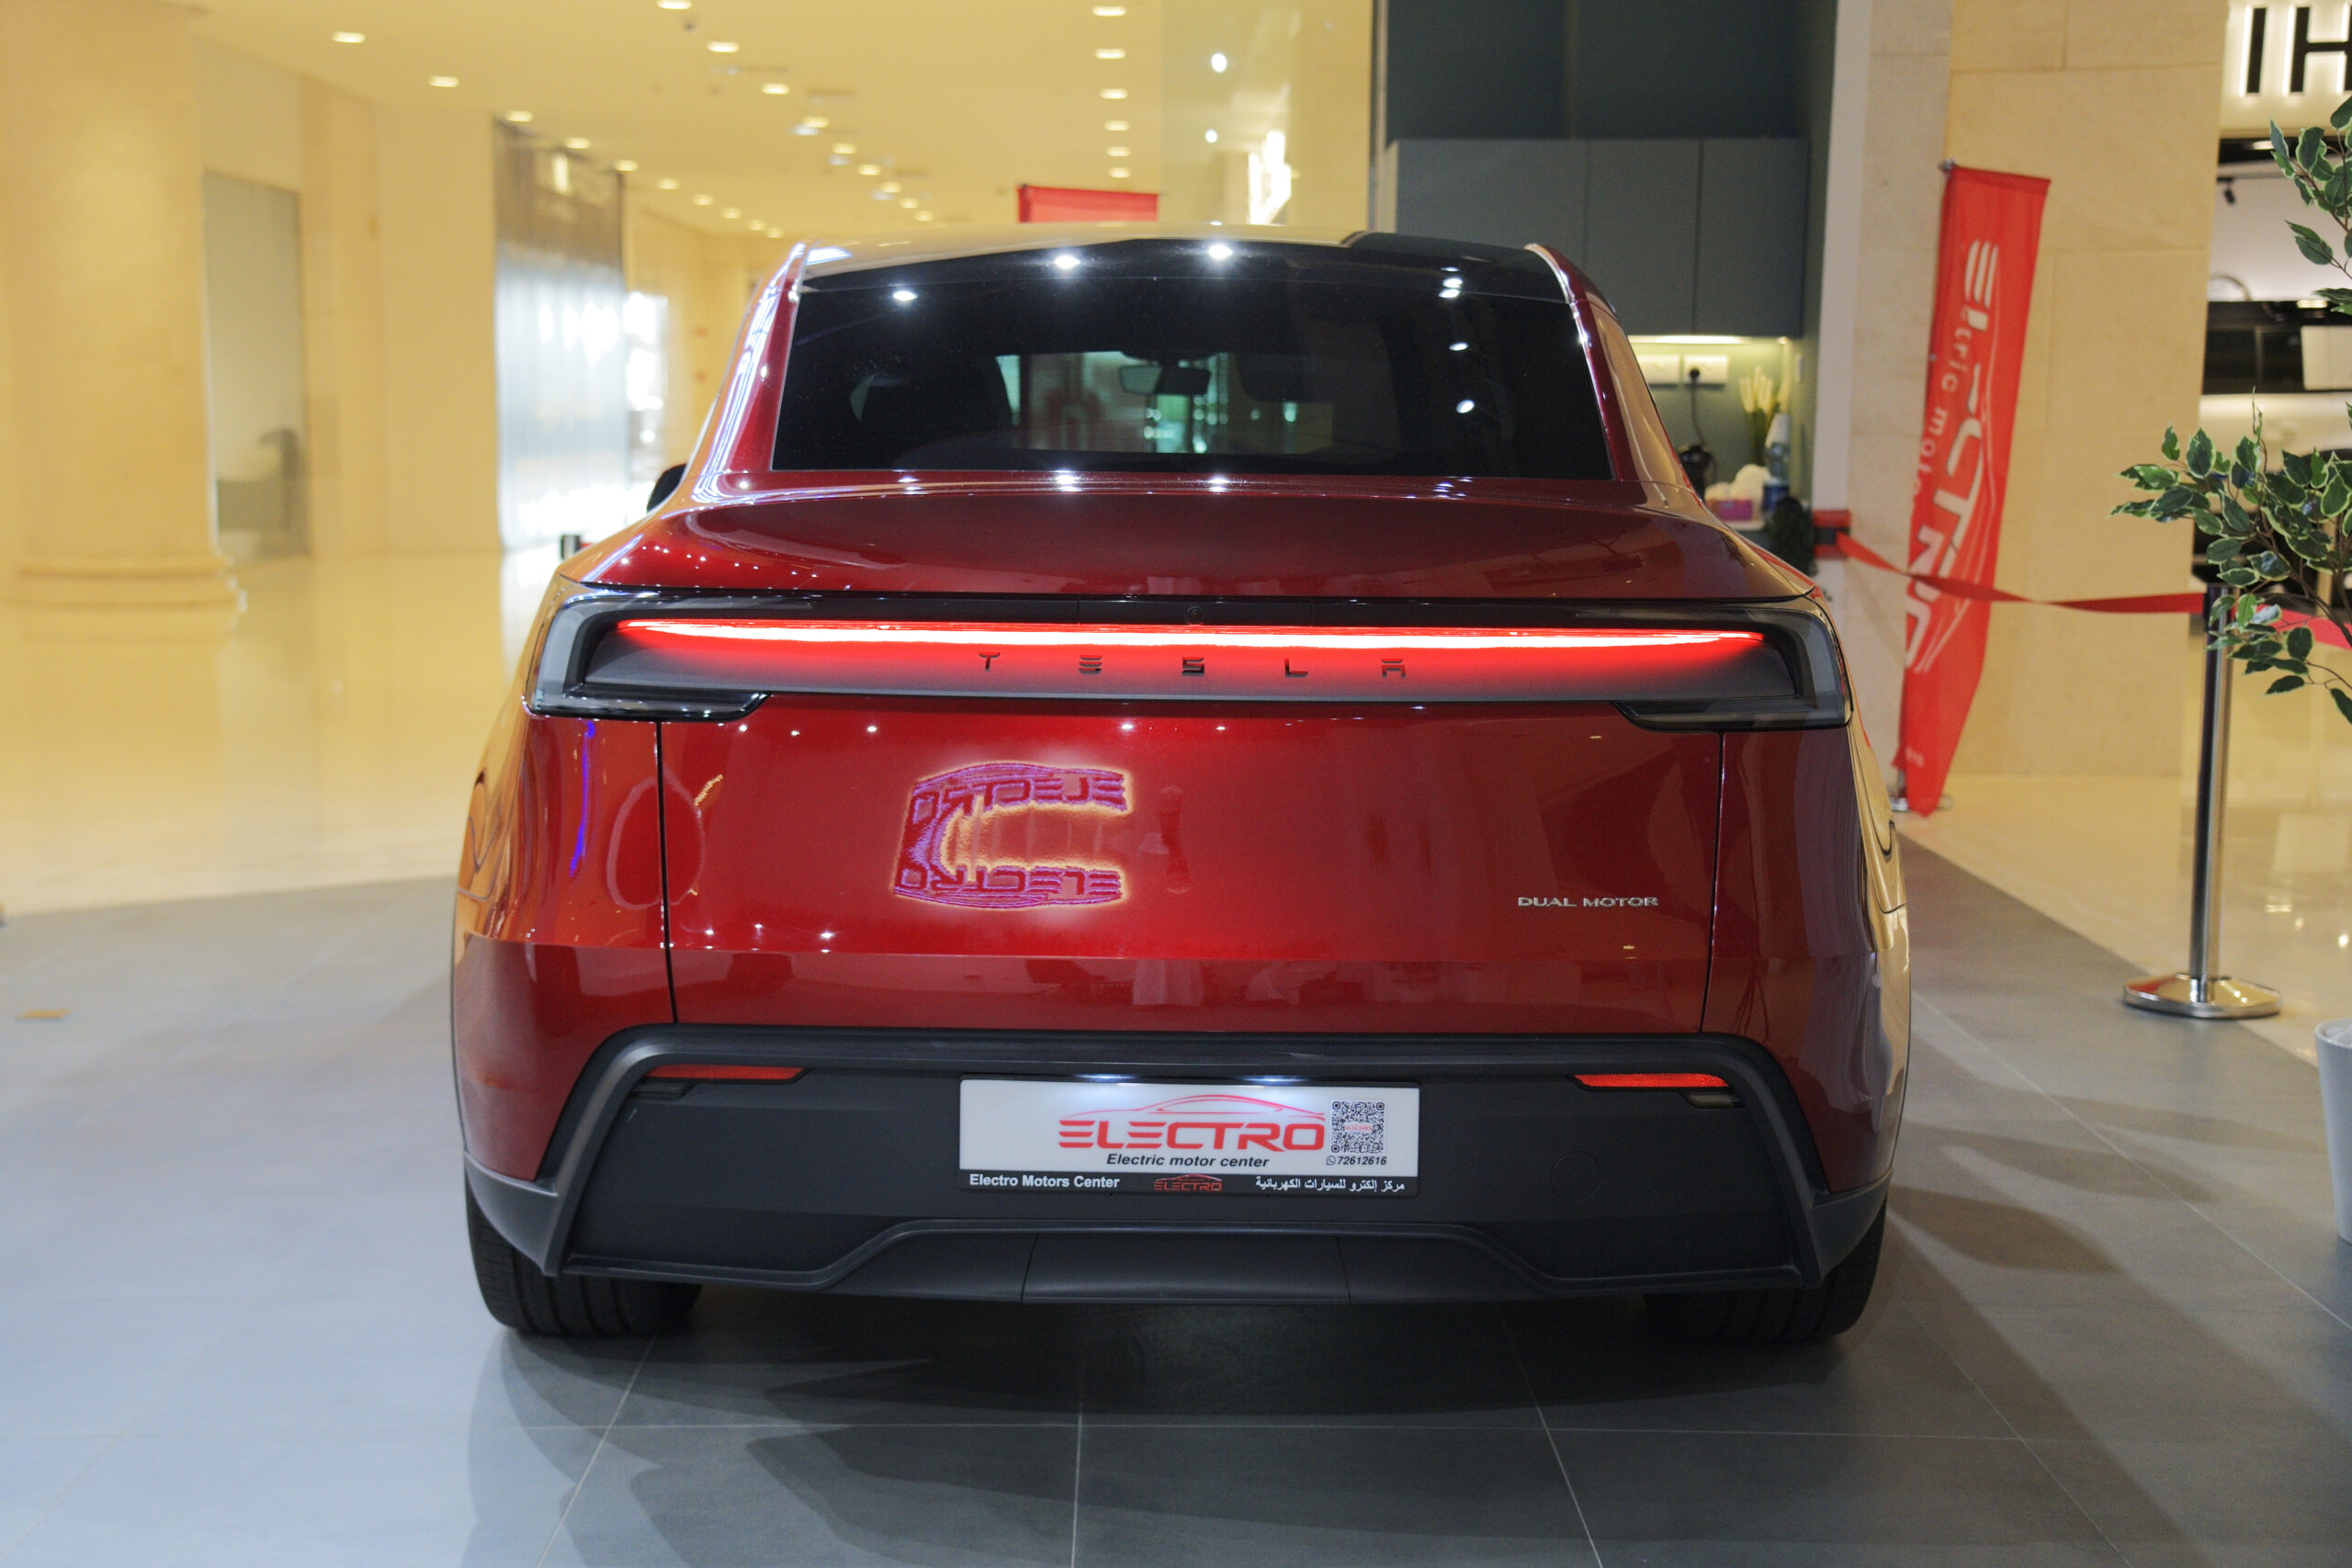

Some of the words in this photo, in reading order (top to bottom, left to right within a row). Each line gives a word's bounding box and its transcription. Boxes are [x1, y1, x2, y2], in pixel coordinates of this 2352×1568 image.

[978, 651, 1407, 677] TESLA
[1518, 897, 1577, 907] DUAL
[1582, 897, 1658, 908] MOTOR
[1058, 1120, 1325, 1152] ELECTRO
[1106, 1153, 1165, 1166] Electric
[1170, 1155, 1216, 1167] motor
[1219, 1156, 1270, 1168] center
[1338, 1156, 1387, 1166] 72612616
[969, 1173, 1018, 1187] Electro
[1022, 1175, 1070, 1188] Motors
[1073, 1175, 1120, 1188] Center
[1154, 1181, 1223, 1191] ELECTRO
[1304, 1179, 1346, 1191] للسيارات
[1381, 1180, 1405, 1192] مركز
